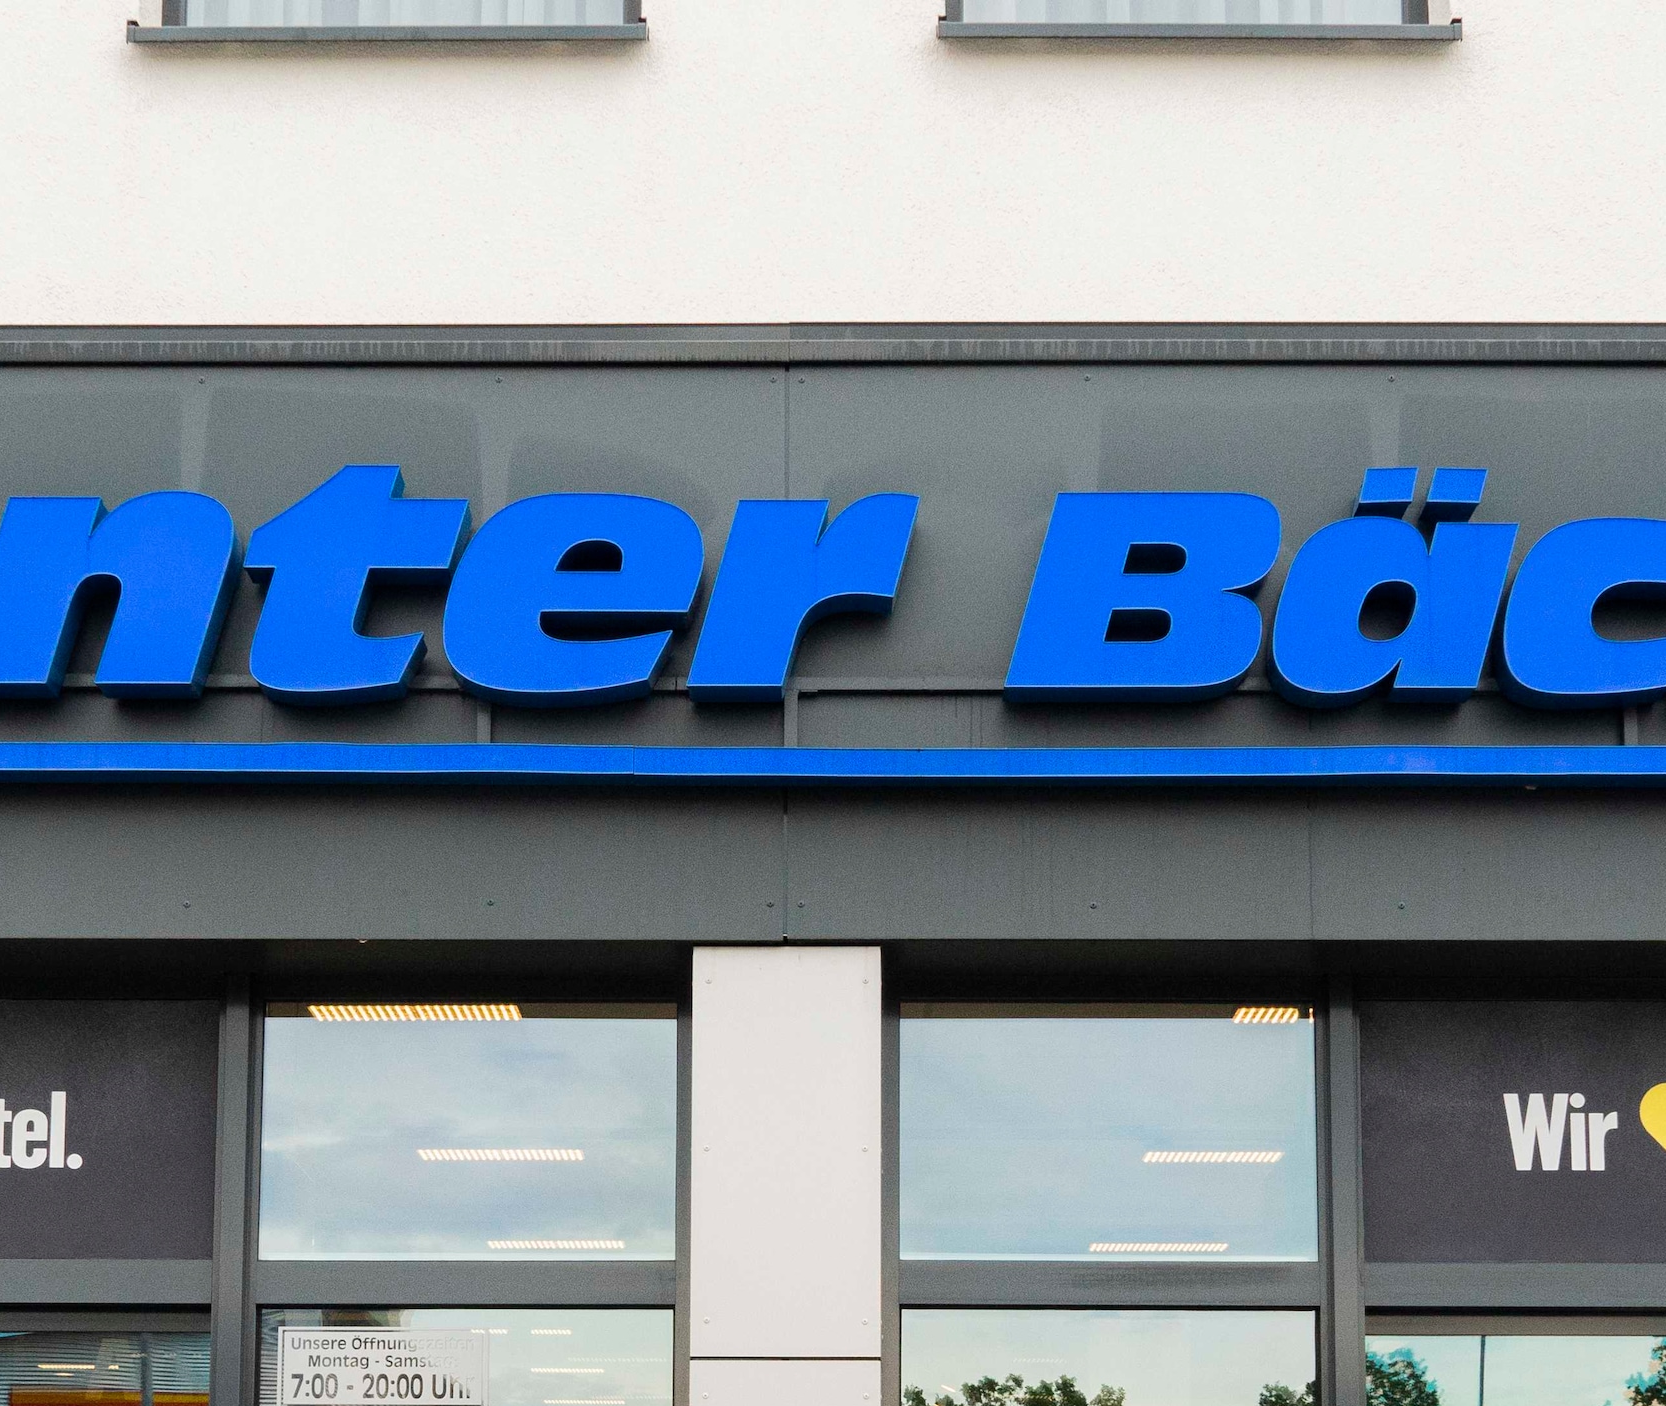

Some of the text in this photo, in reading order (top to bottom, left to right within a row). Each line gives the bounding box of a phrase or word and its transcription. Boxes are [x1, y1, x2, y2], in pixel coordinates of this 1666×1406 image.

[1503, 1093, 1619, 1171] Wir
[291, 1337, 346, 1350] Unsere
[308, 1355, 369, 1369] Montag
[291, 1373, 475, 1399] 7:00 20:00 Uhr
